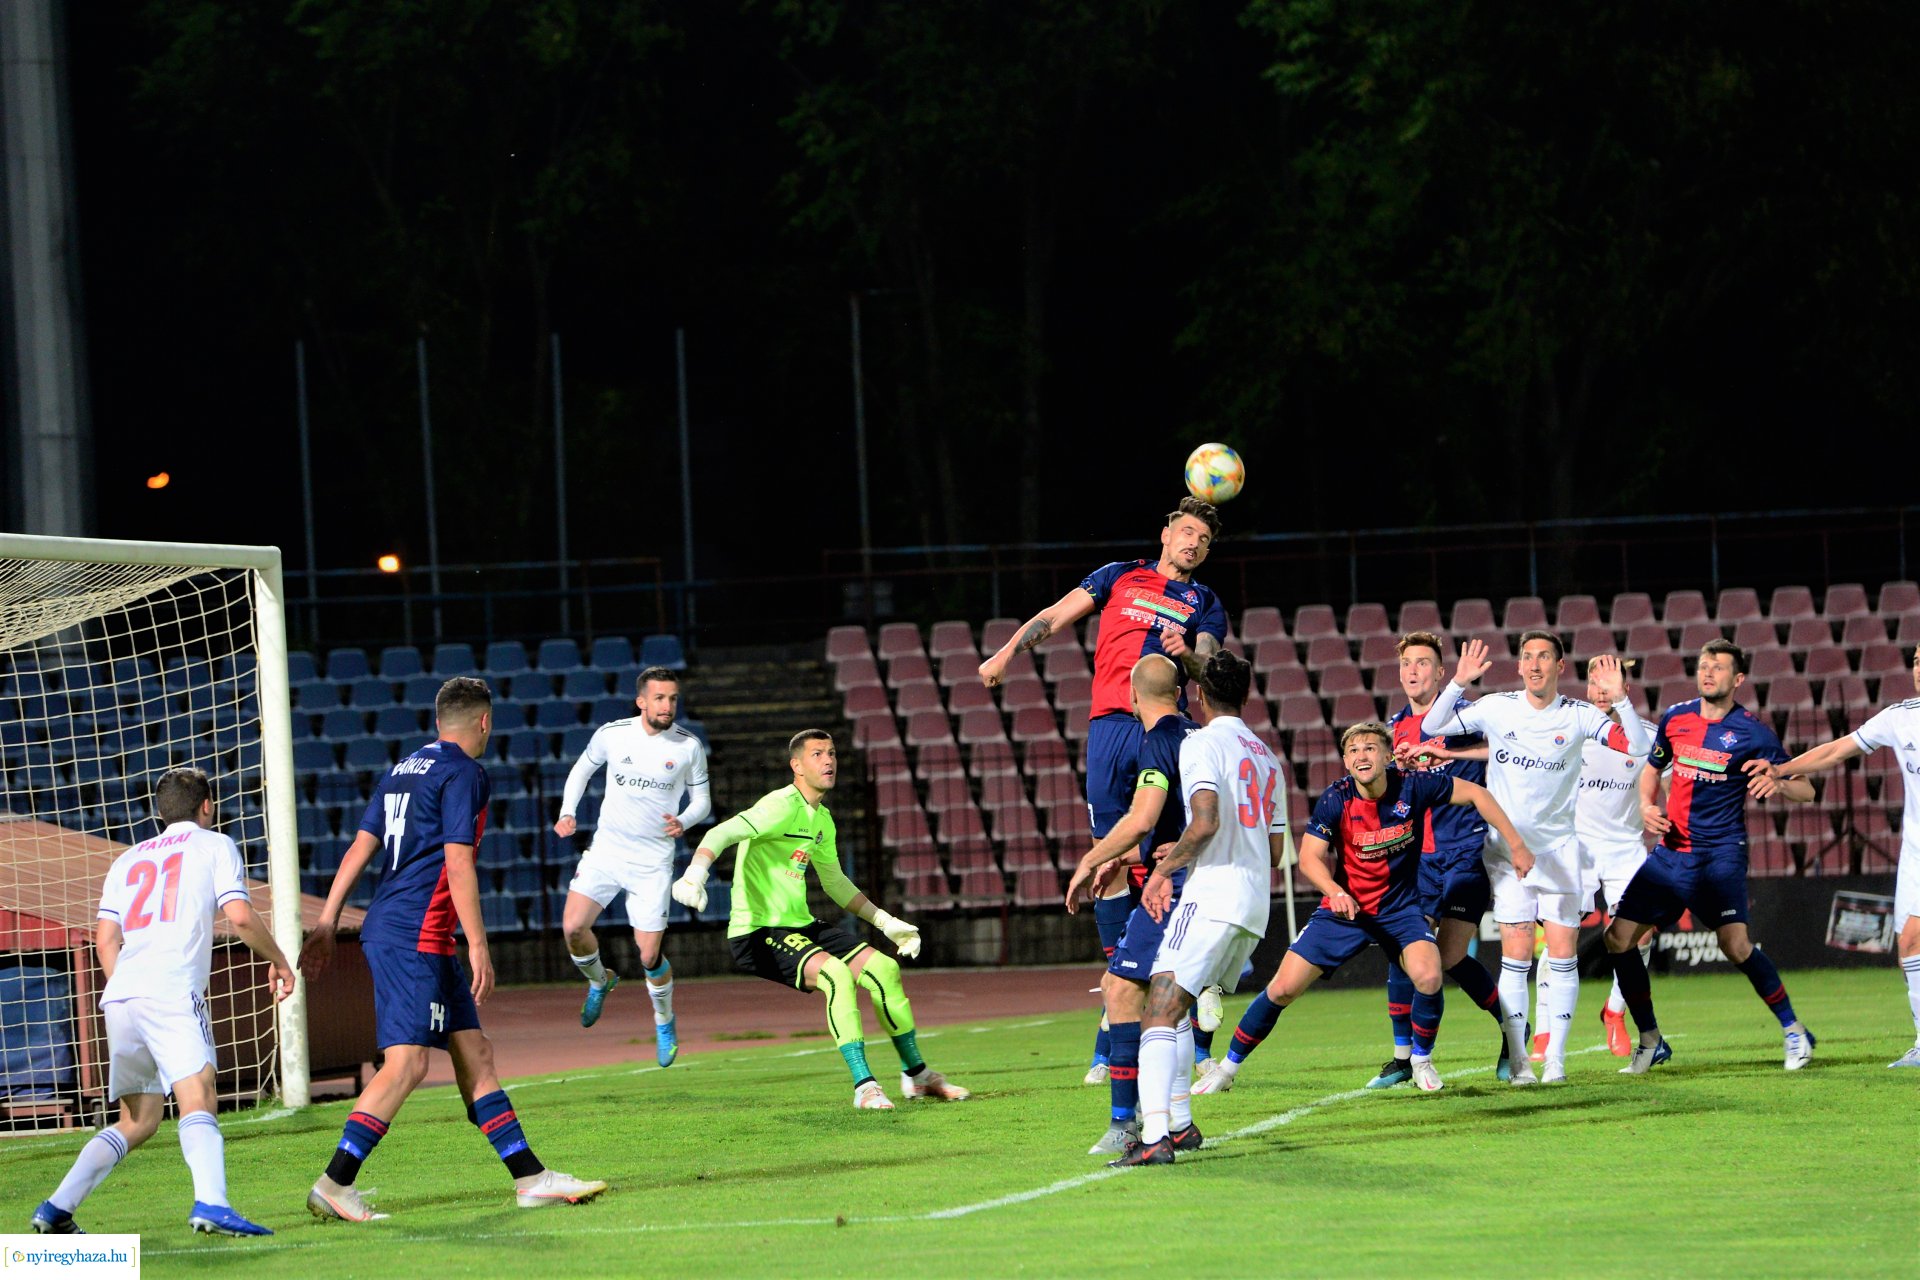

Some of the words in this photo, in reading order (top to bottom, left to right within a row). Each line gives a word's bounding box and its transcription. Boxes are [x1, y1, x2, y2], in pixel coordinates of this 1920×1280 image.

[1143, 771, 1156, 785] C
[1512, 755, 1567, 772] otpbank
[1237, 757, 1277, 829] 34
[122, 851, 184, 934] 21
[429, 1001, 446, 1033] 14
